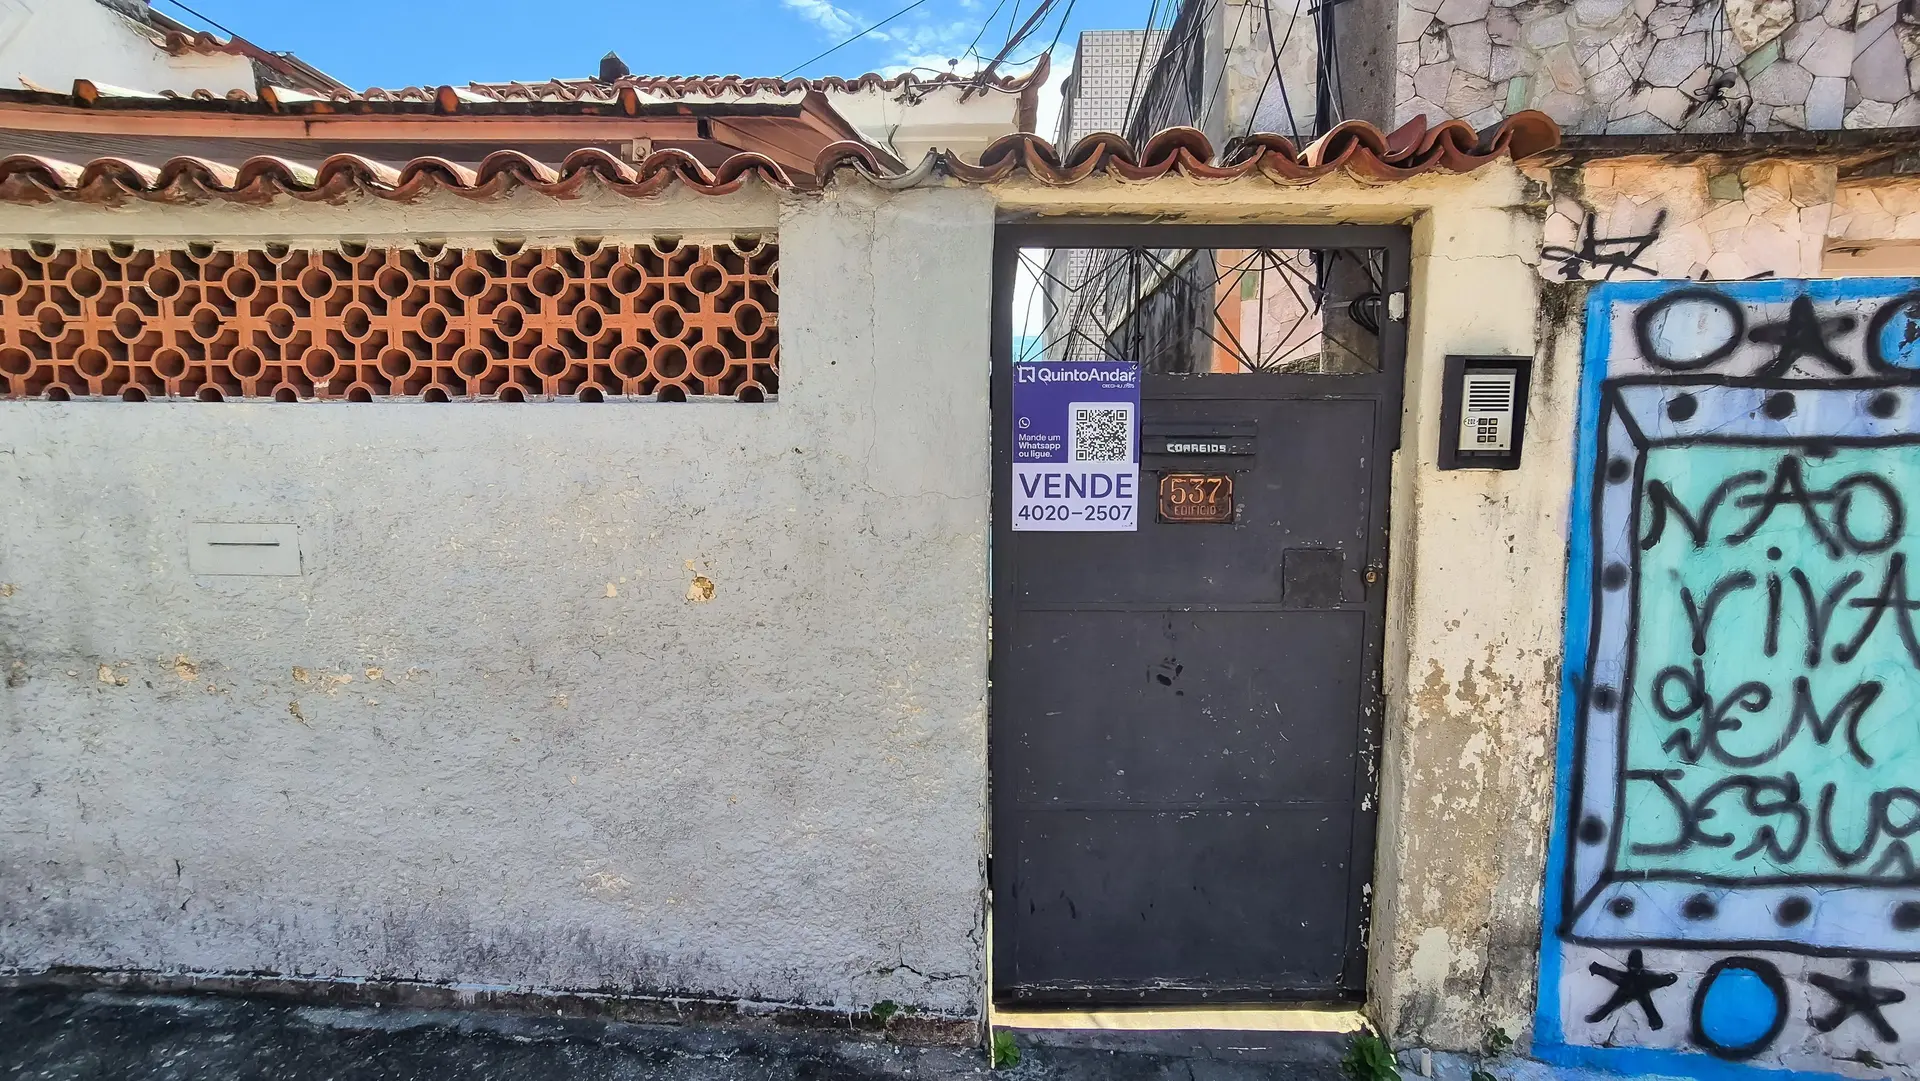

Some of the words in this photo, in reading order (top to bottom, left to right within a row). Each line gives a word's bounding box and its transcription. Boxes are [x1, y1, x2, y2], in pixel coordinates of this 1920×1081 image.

[1038, 367, 1135, 384] QuintoAndar
[1018, 433, 1046, 442] Mande
[1018, 441, 1061, 451] Whatsapp
[1030, 449, 1053, 459] ligue.
[1019, 473, 1133, 499] VENDE
[1170, 478, 1222, 504] 537
[1018, 504, 1133, 521] 4020-2507
